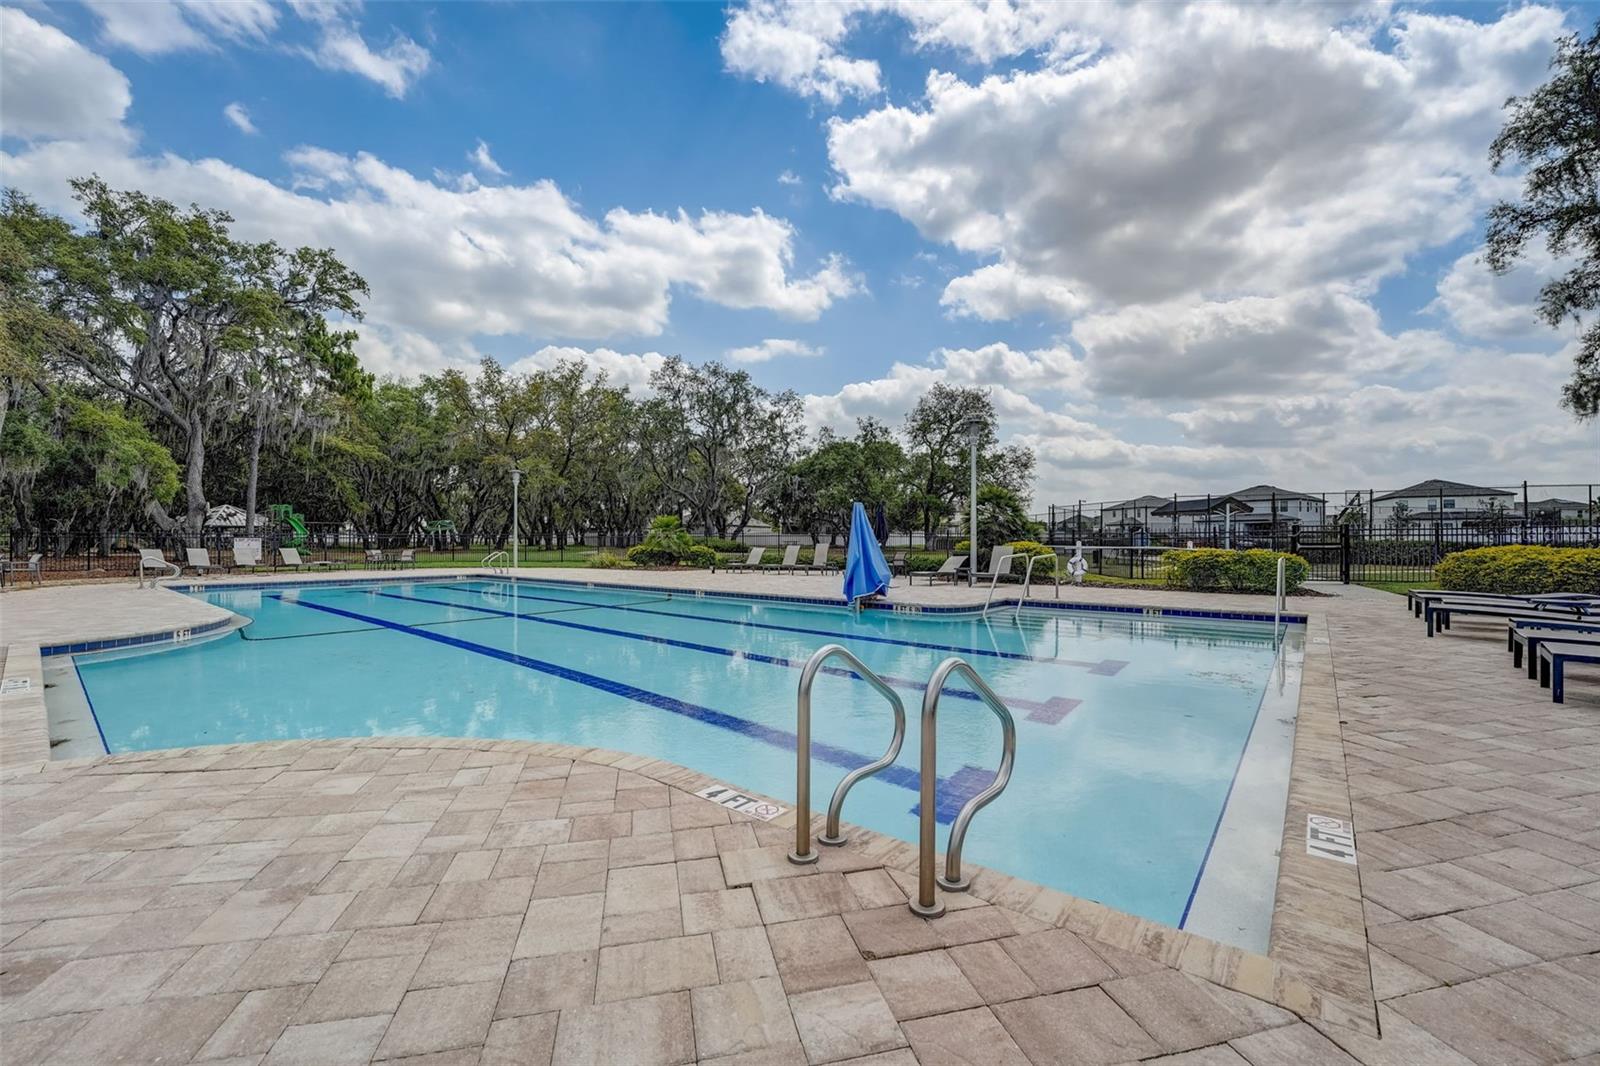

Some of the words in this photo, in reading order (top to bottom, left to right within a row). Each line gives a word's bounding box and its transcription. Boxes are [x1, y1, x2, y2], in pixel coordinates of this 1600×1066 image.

[705, 789, 729, 799] 4
[720, 794, 759, 809] FT
[1310, 827, 1352, 847] FT
[1309, 844, 1354, 858] 4
